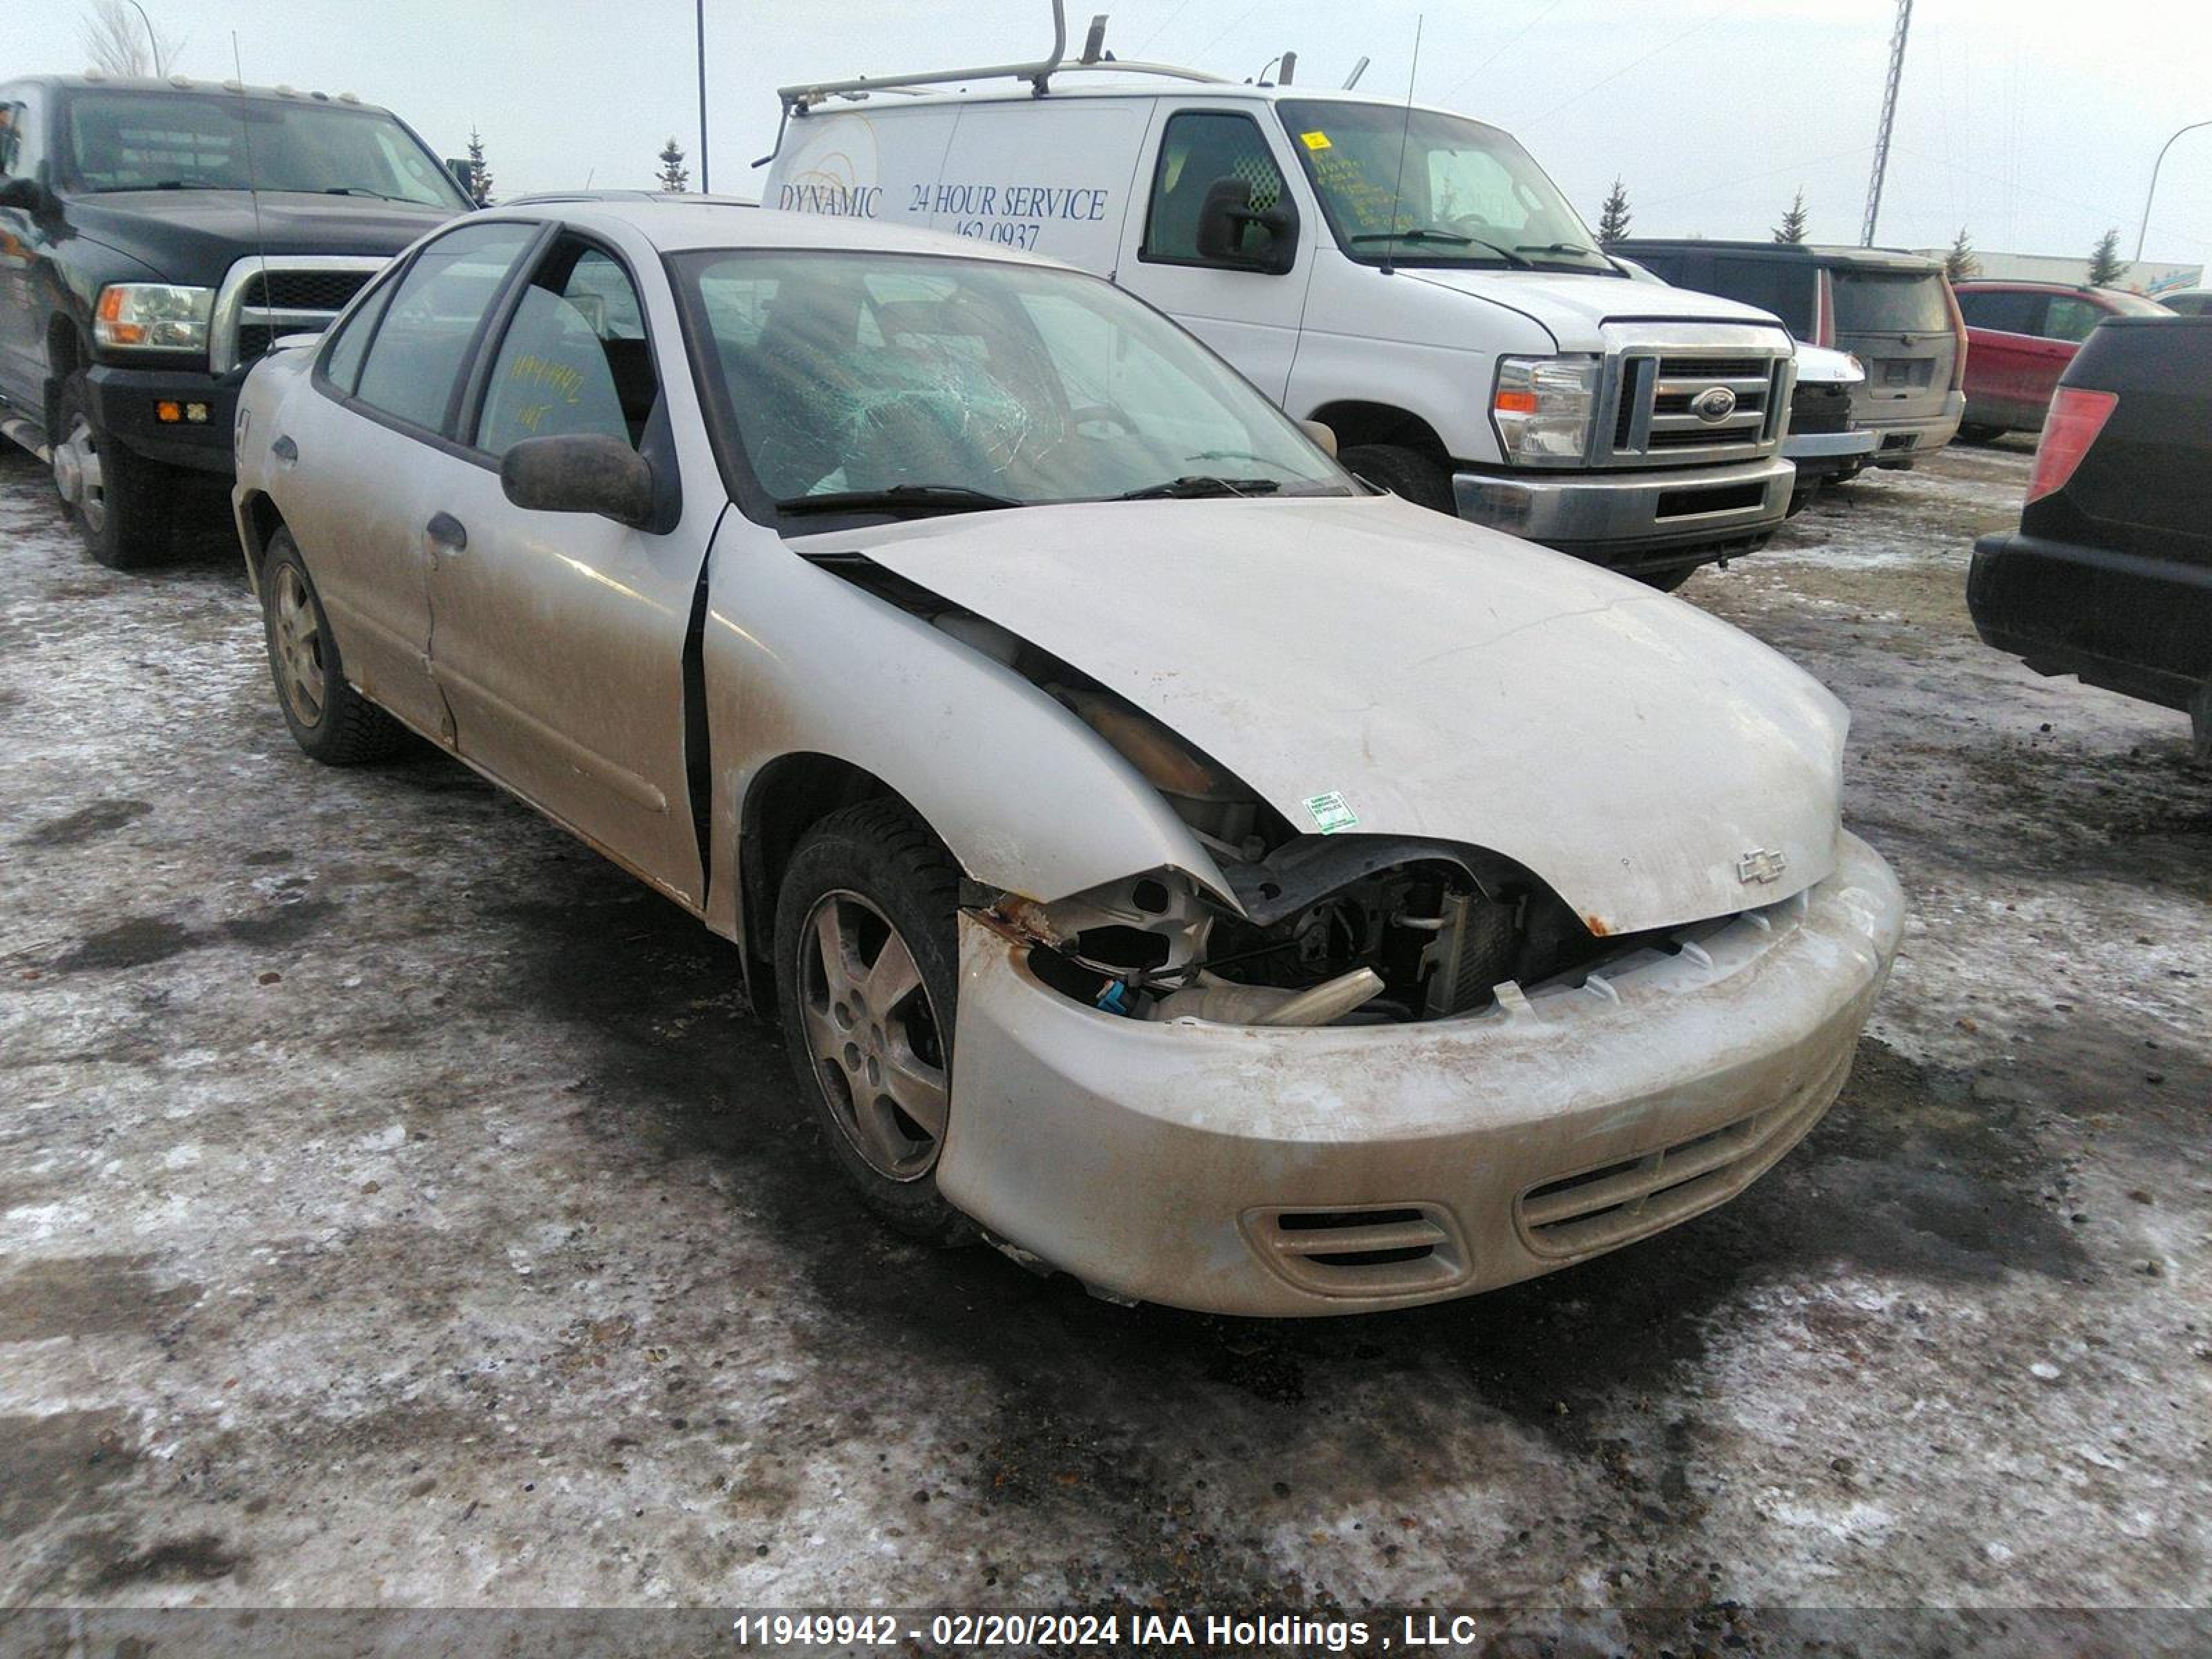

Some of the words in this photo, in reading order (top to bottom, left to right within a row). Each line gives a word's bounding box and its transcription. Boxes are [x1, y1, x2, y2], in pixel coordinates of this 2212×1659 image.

[778, 185, 883, 219] DYNAMIC
[908, 183, 930, 211] 24
[933, 185, 996, 215] HOUR
[1002, 187, 1108, 221] SERVICE
